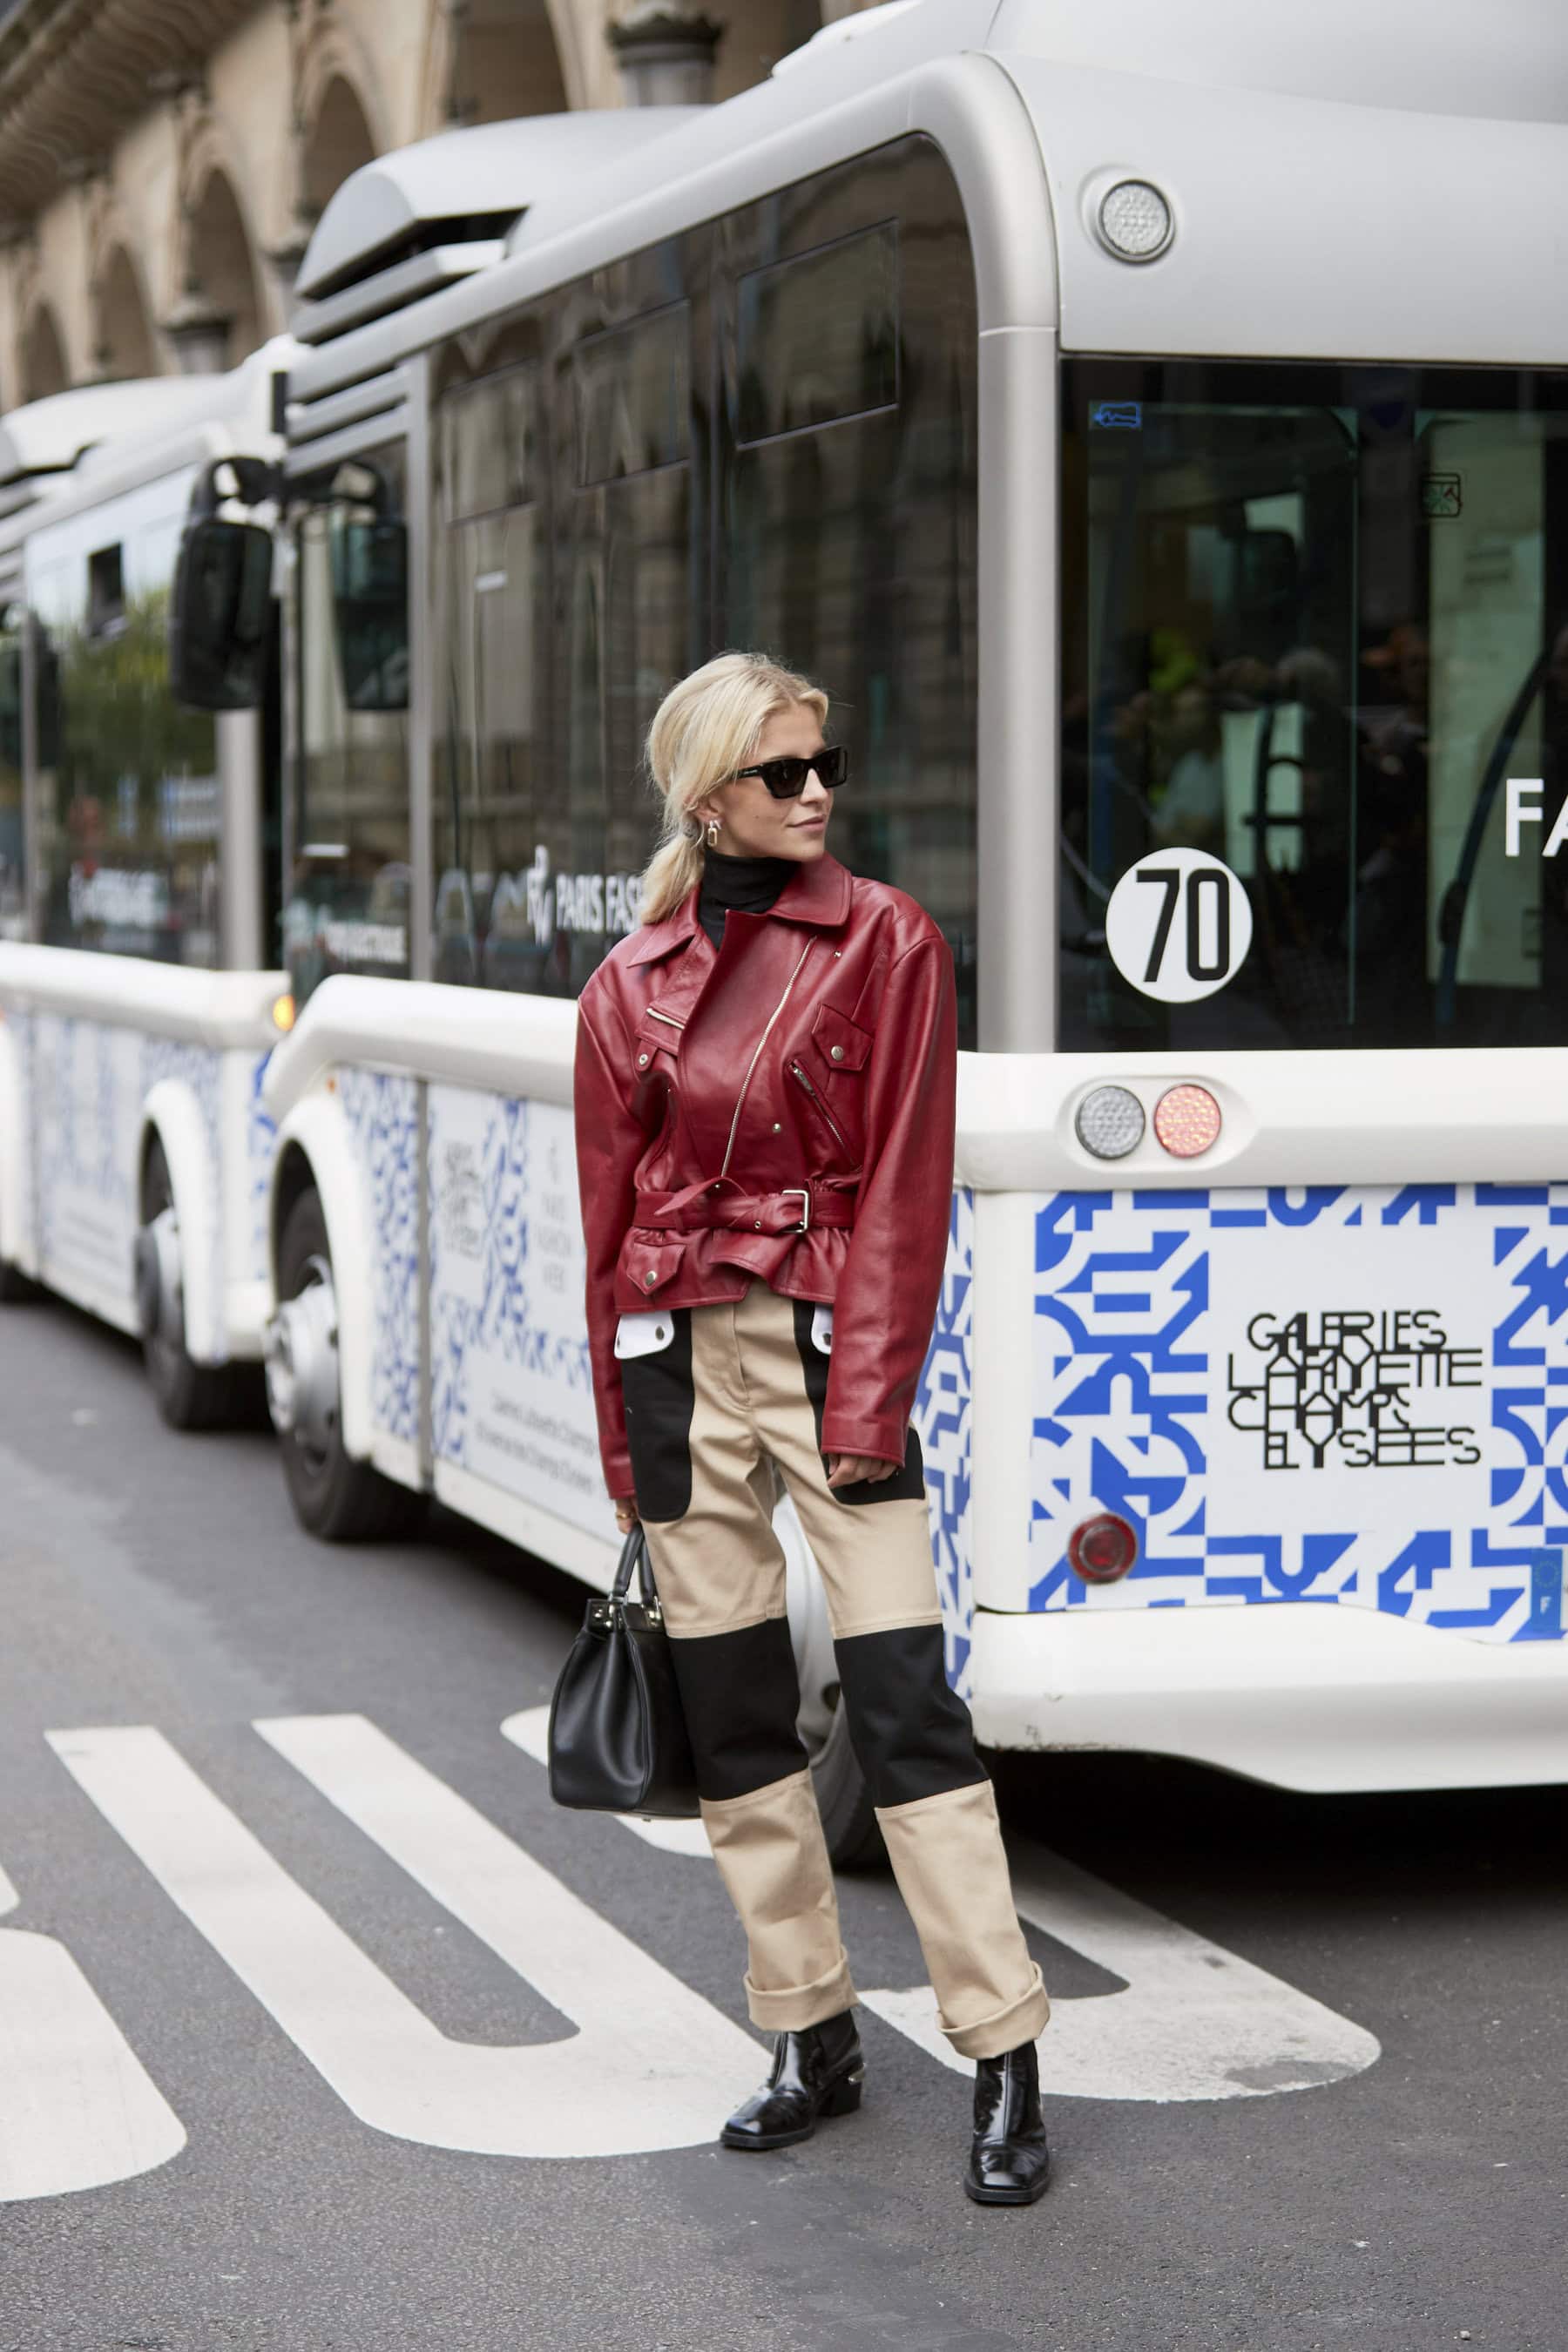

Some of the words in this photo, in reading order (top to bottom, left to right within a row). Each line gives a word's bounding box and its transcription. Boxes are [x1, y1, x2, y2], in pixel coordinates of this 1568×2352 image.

[556, 874, 605, 933] PARIS
[605, 875, 643, 934] FAS
[1136, 868, 1230, 983] 70
[1247, 1310, 1447, 1351] GALERIES
[1228, 1348, 1483, 1391] LAFAYETTE
